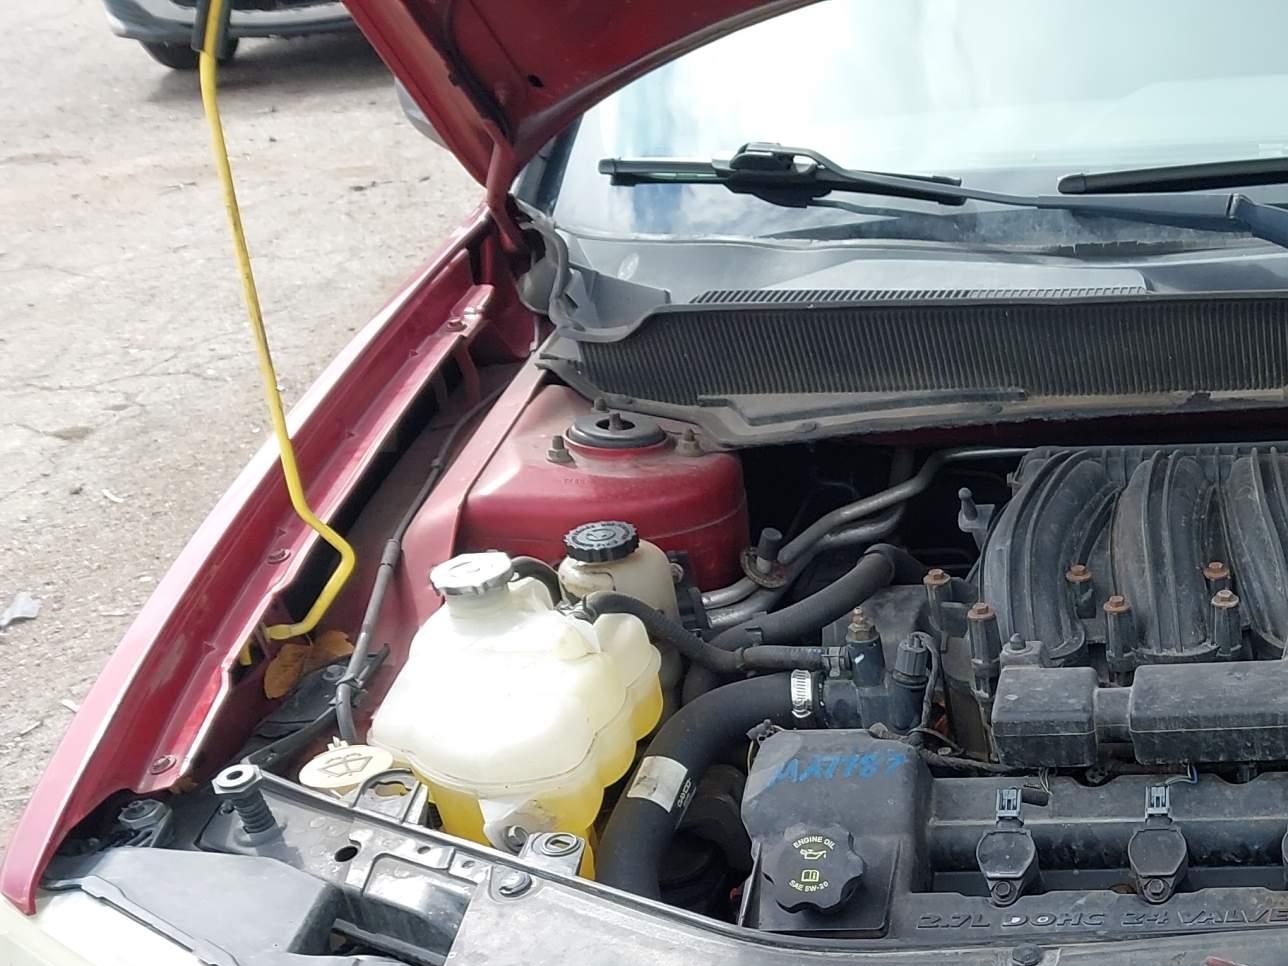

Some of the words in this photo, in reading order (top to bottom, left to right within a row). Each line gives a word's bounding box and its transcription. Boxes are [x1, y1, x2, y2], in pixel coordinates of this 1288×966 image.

[793, 836, 823, 849] ENGINE
[823, 838, 836, 850] OIL
[789, 879, 804, 892] SAE
[916, 912, 991, 929] 2.7L
[1001, 911, 1106, 928] DOHC
[1121, 910, 1169, 926] 24
